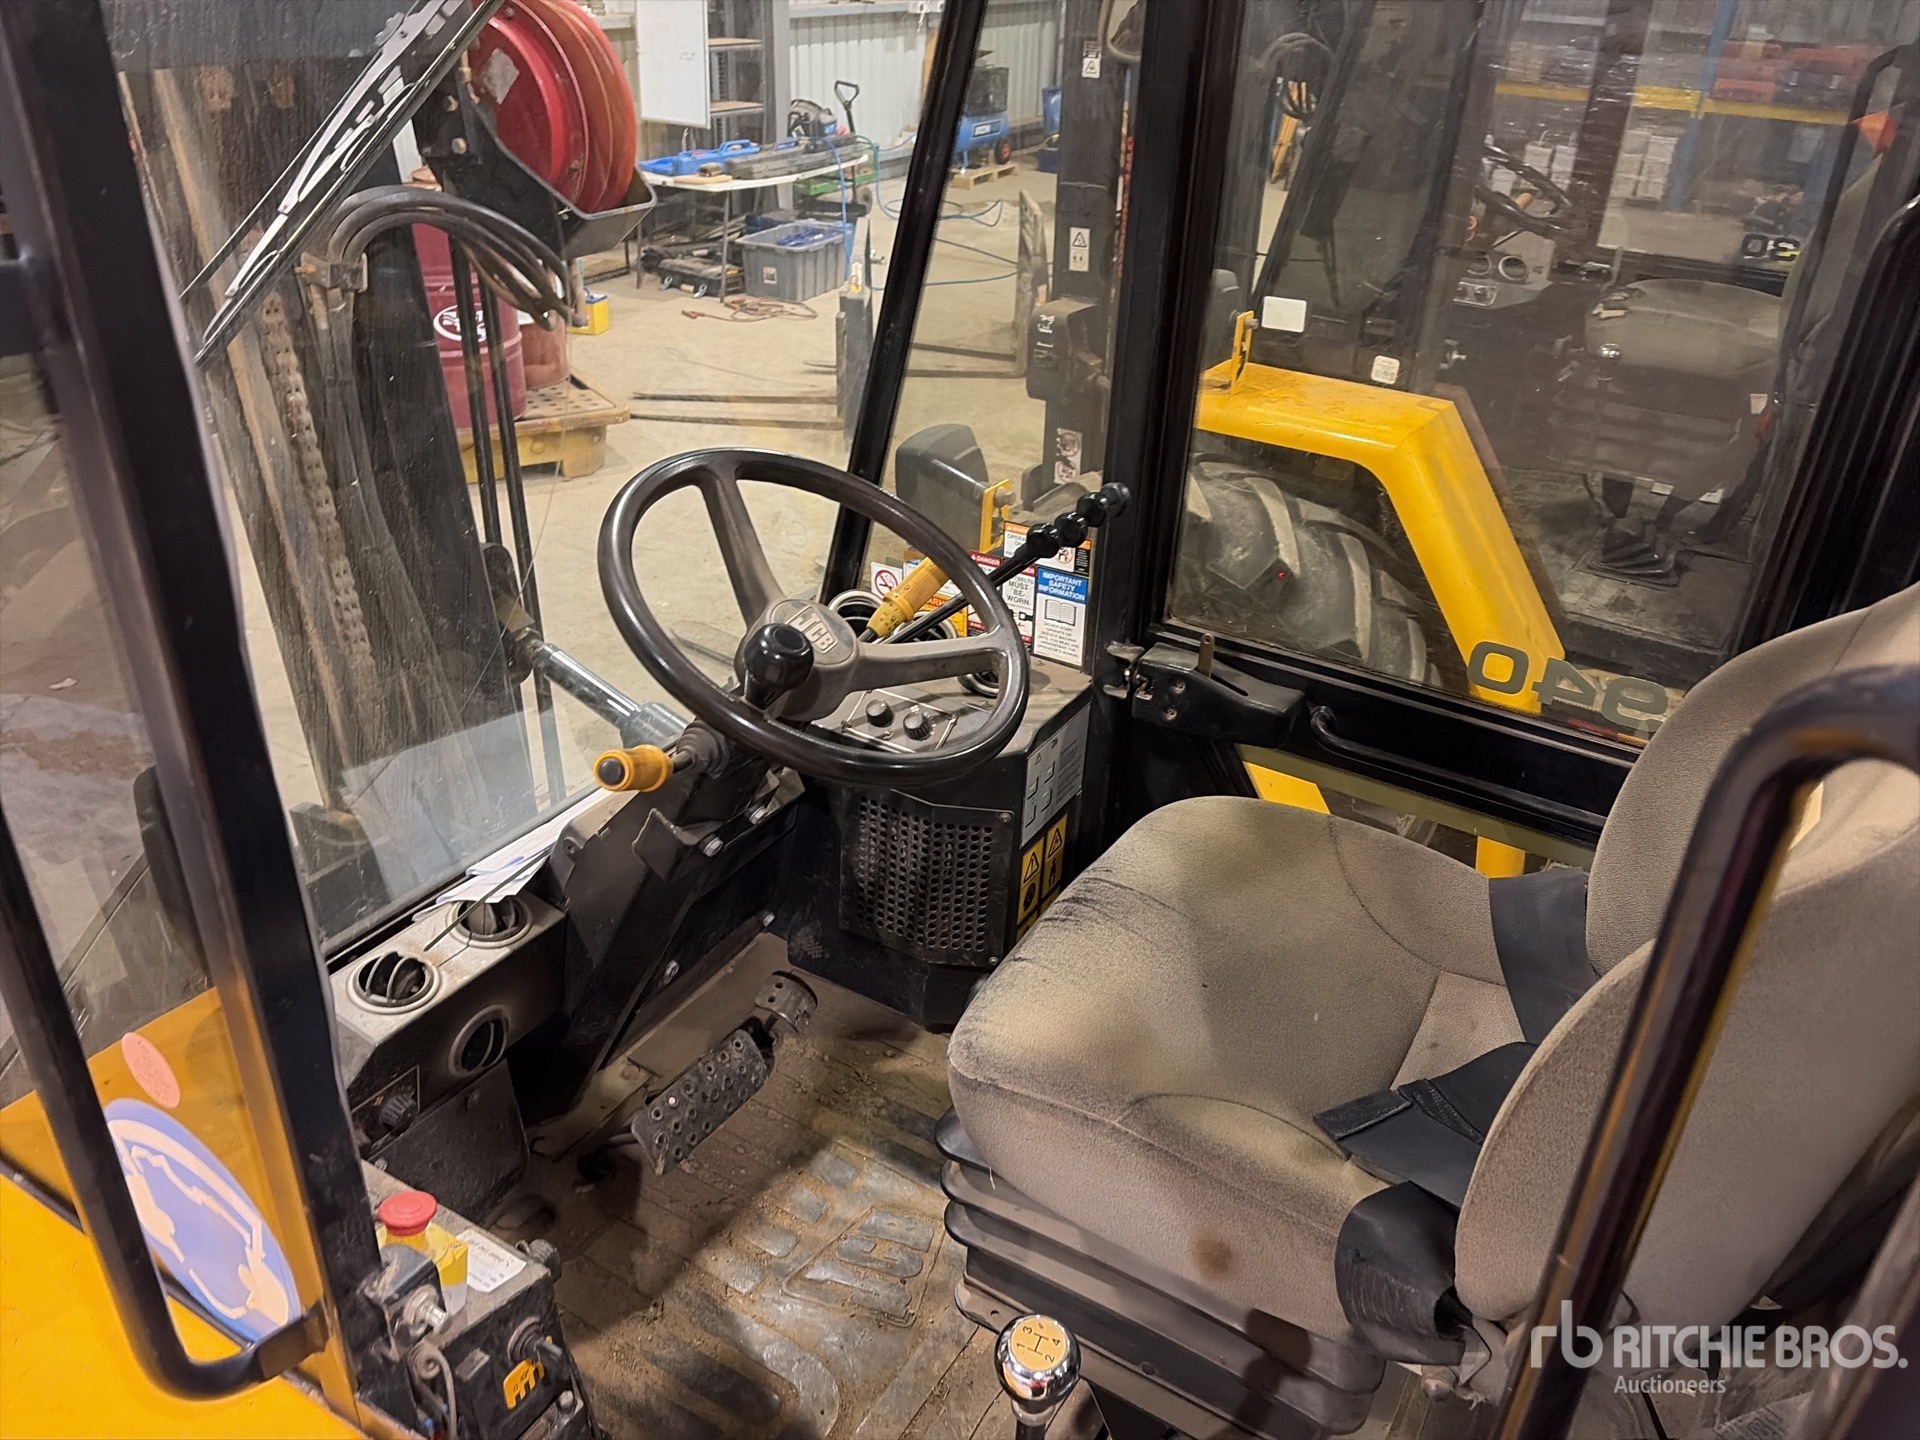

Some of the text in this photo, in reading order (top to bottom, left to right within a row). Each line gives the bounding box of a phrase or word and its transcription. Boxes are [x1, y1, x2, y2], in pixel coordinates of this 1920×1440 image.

[976, 555, 1000, 567] DANGER
[1042, 571, 1082, 587] IMPORTANT
[1008, 581, 1029, 591] MUST
[1048, 579, 1076, 592] SAFETY
[1038, 584, 1086, 601] INFORMATION
[1006, 594, 1030, 605] WORN
[1022, 1325, 1033, 1335] 3
[1052, 1338, 1061, 1346] 4
[1045, 1354, 1055, 1362] 2
